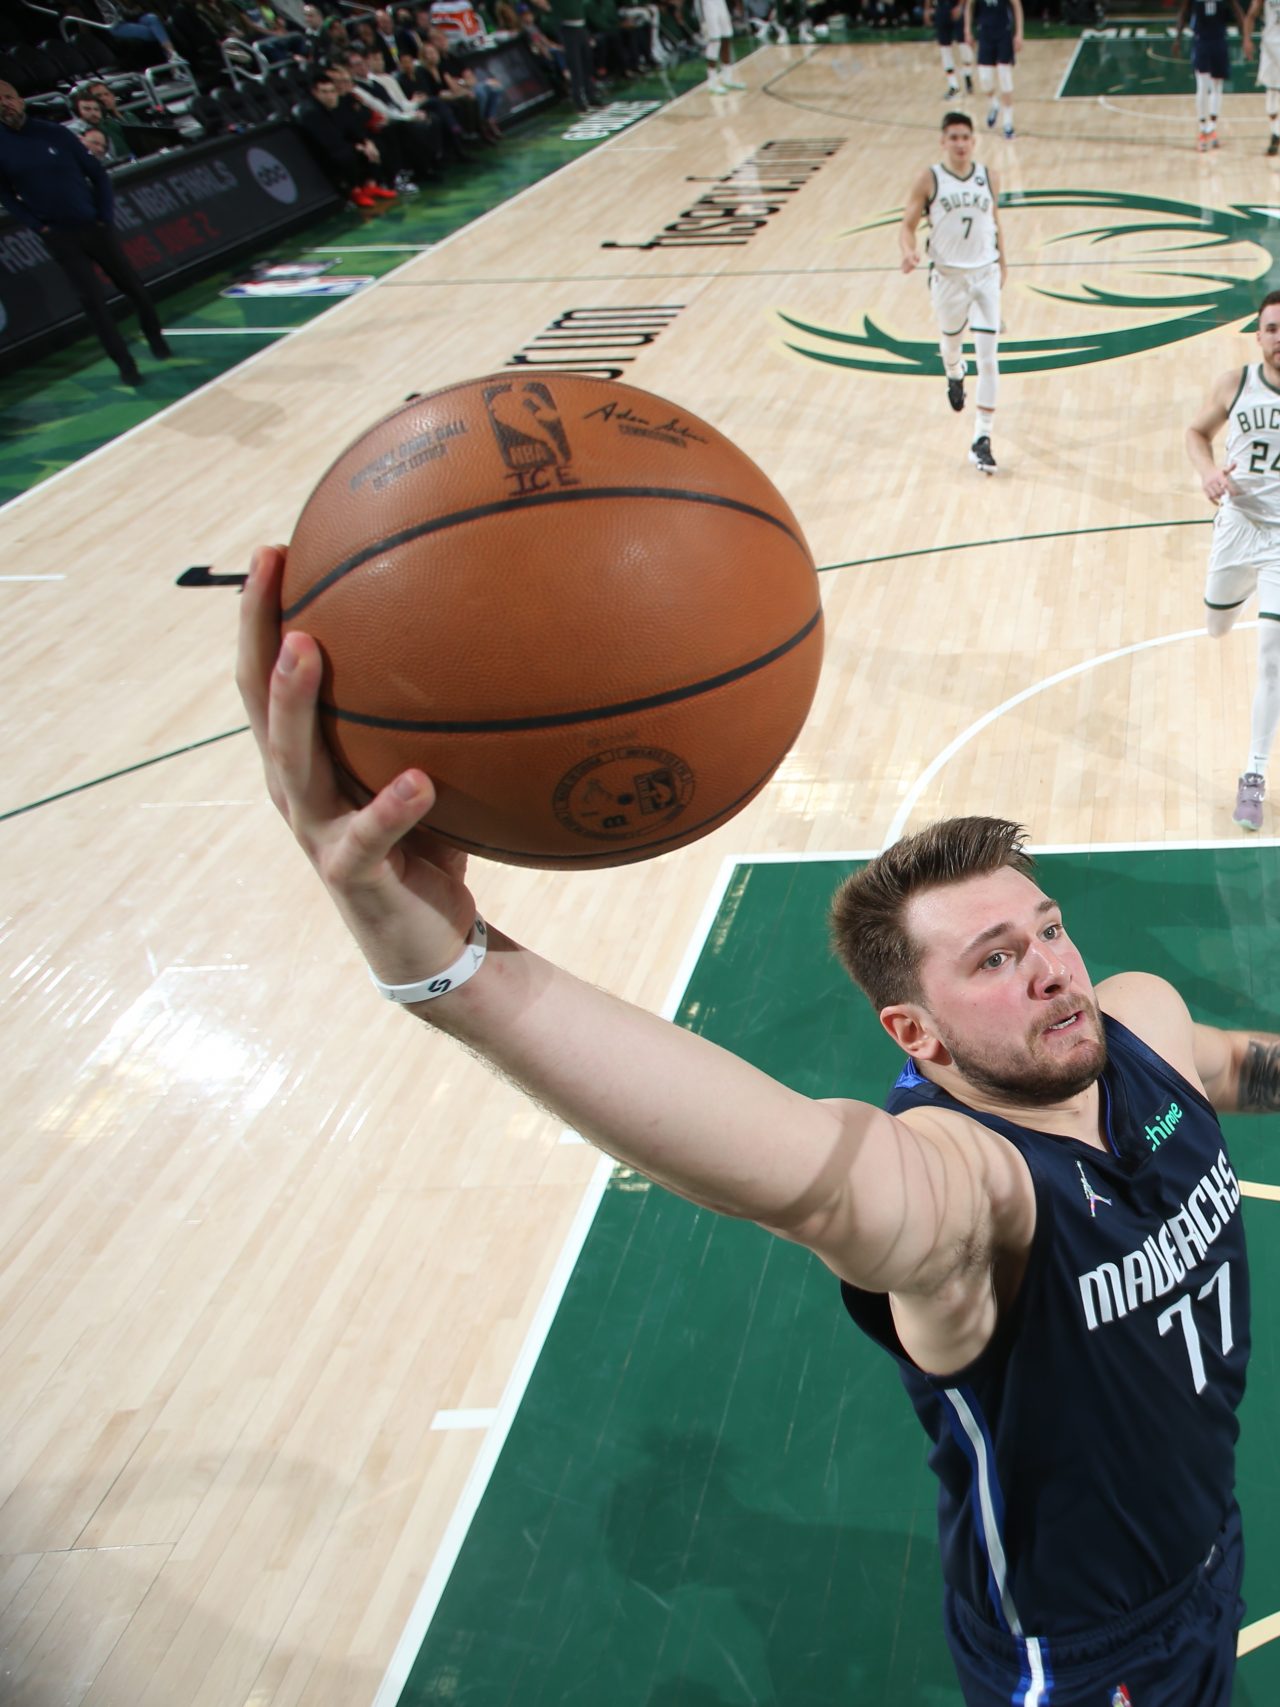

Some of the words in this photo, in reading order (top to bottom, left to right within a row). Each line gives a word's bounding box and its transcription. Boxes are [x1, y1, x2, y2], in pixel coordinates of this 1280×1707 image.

[166, 160, 239, 206] FINALS
[940, 191, 990, 213] BUCKS
[961, 216, 974, 240] 7
[510, 444, 547, 465] NBA
[504, 465, 581, 497] ICE
[1157, 1260, 1235, 1396] 77
